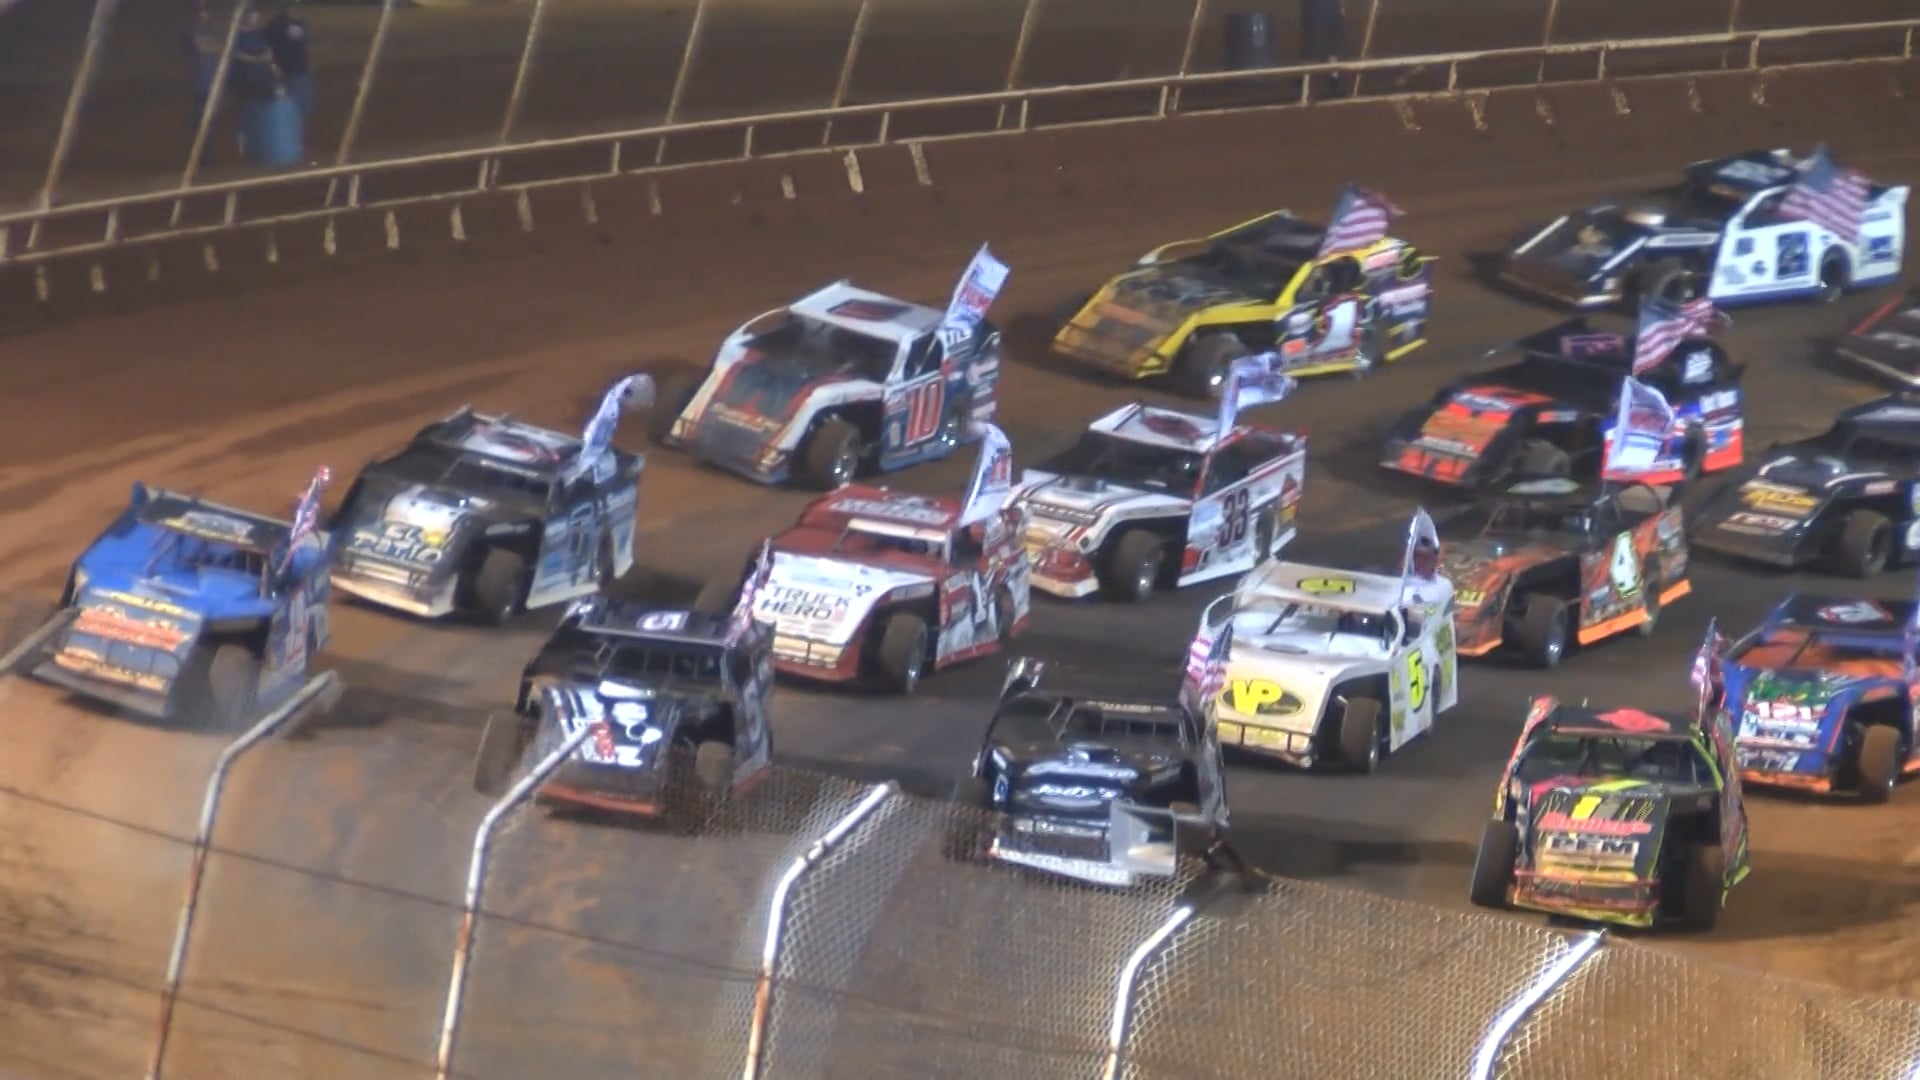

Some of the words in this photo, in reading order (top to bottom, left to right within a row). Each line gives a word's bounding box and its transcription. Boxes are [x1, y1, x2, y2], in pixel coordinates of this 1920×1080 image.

[1218, 488, 1249, 548] 33
[760, 598, 832, 620] HERO
[774, 586, 849, 607] TRUCK
[1231, 679, 1282, 716] VP
[1407, 648, 1428, 713] 5
